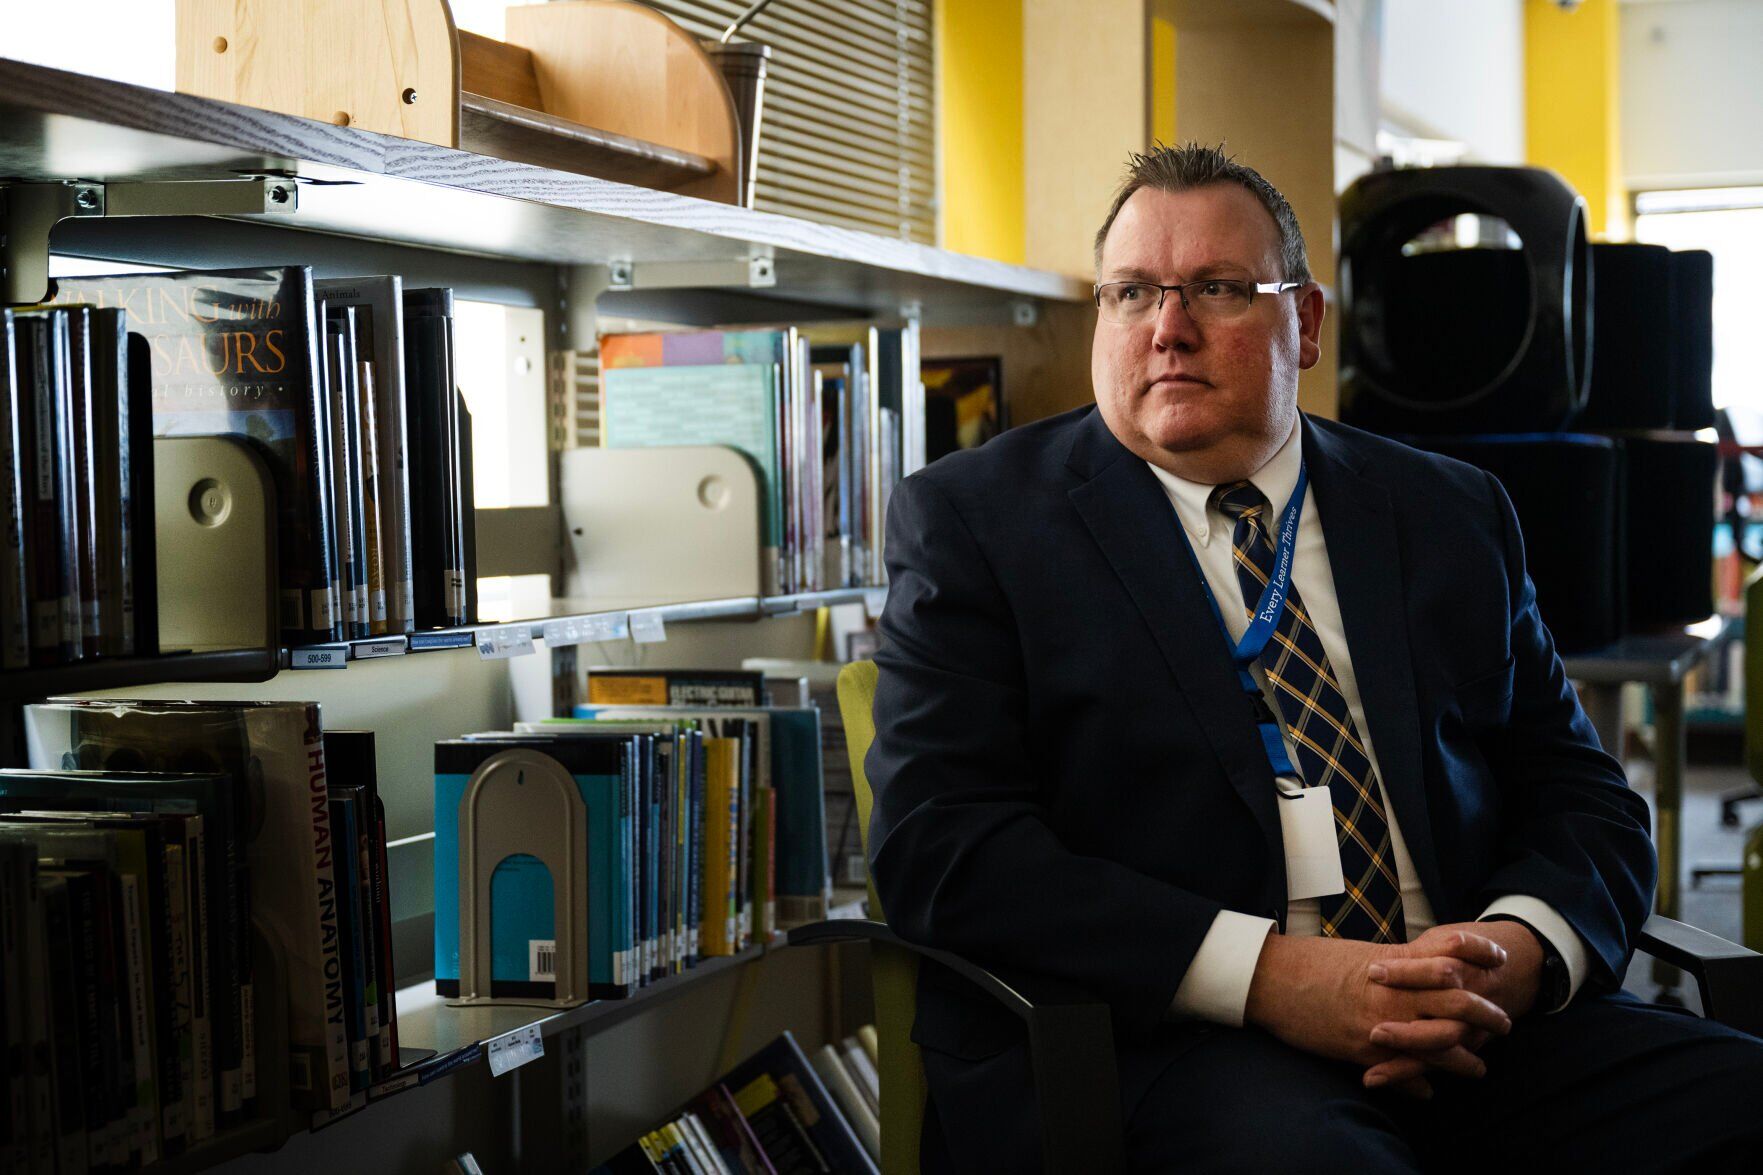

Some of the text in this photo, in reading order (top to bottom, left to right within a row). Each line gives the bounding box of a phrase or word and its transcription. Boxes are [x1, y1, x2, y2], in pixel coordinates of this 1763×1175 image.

[322, 288, 361, 299] Animals
[228, 296, 281, 320] with
[153, 329, 287, 377] SAURS
[184, 384, 264, 399] history
[1260, 506, 1297, 623] Every Learner Thrives
[307, 654, 331, 664] 500-599
[371, 645, 389, 653] Science
[308, 749, 333, 869] HUMAN
[317, 878, 344, 1025] ANATOMY
